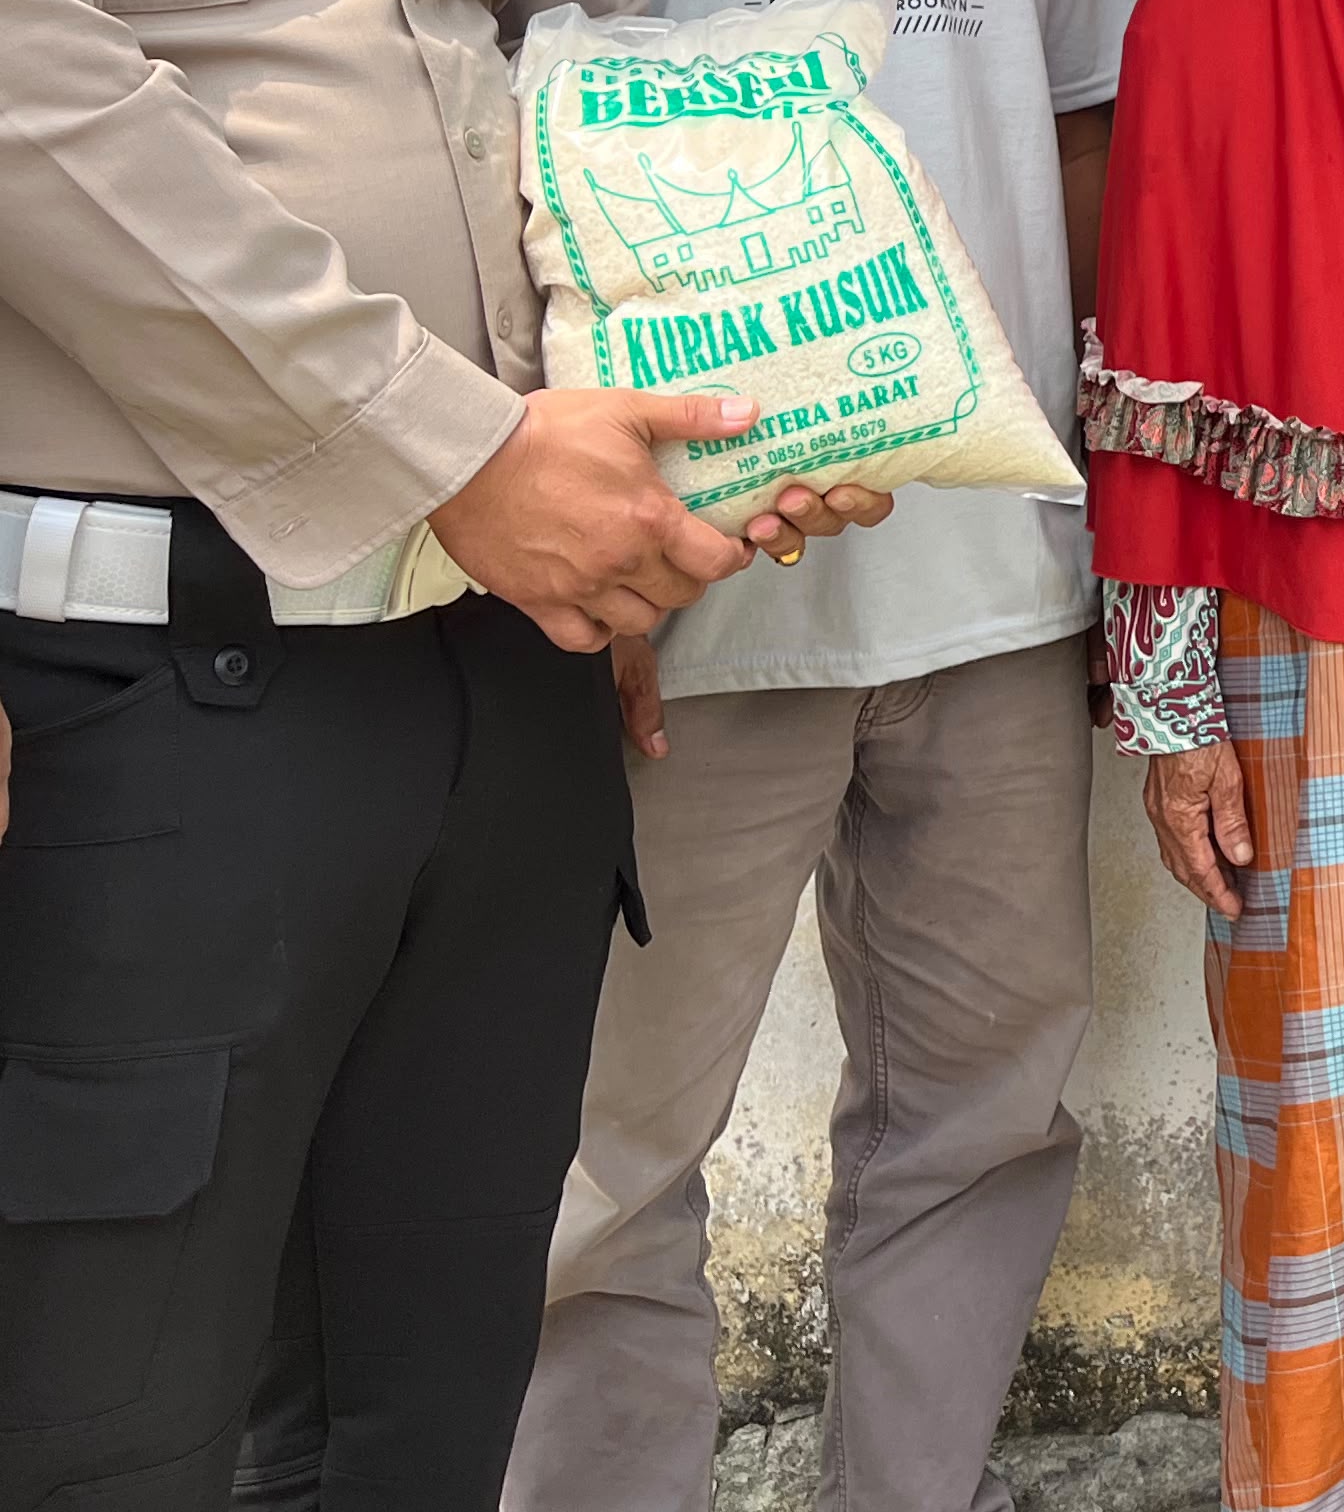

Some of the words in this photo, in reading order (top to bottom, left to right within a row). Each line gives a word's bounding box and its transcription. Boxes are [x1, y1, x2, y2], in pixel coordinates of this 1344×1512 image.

[622, 301, 777, 390] KURIAK
[782, 242, 929, 347] KUSUIK
[863, 350, 876, 368] 5
[878, 341, 908, 363] KG
[685, 402, 831, 461] SUMATERA
[836, 375, 920, 418] BARAT
[767, 443, 806, 466] 0852
[809, 430, 847, 452] 6594
[851, 418, 887, 440] 5679
